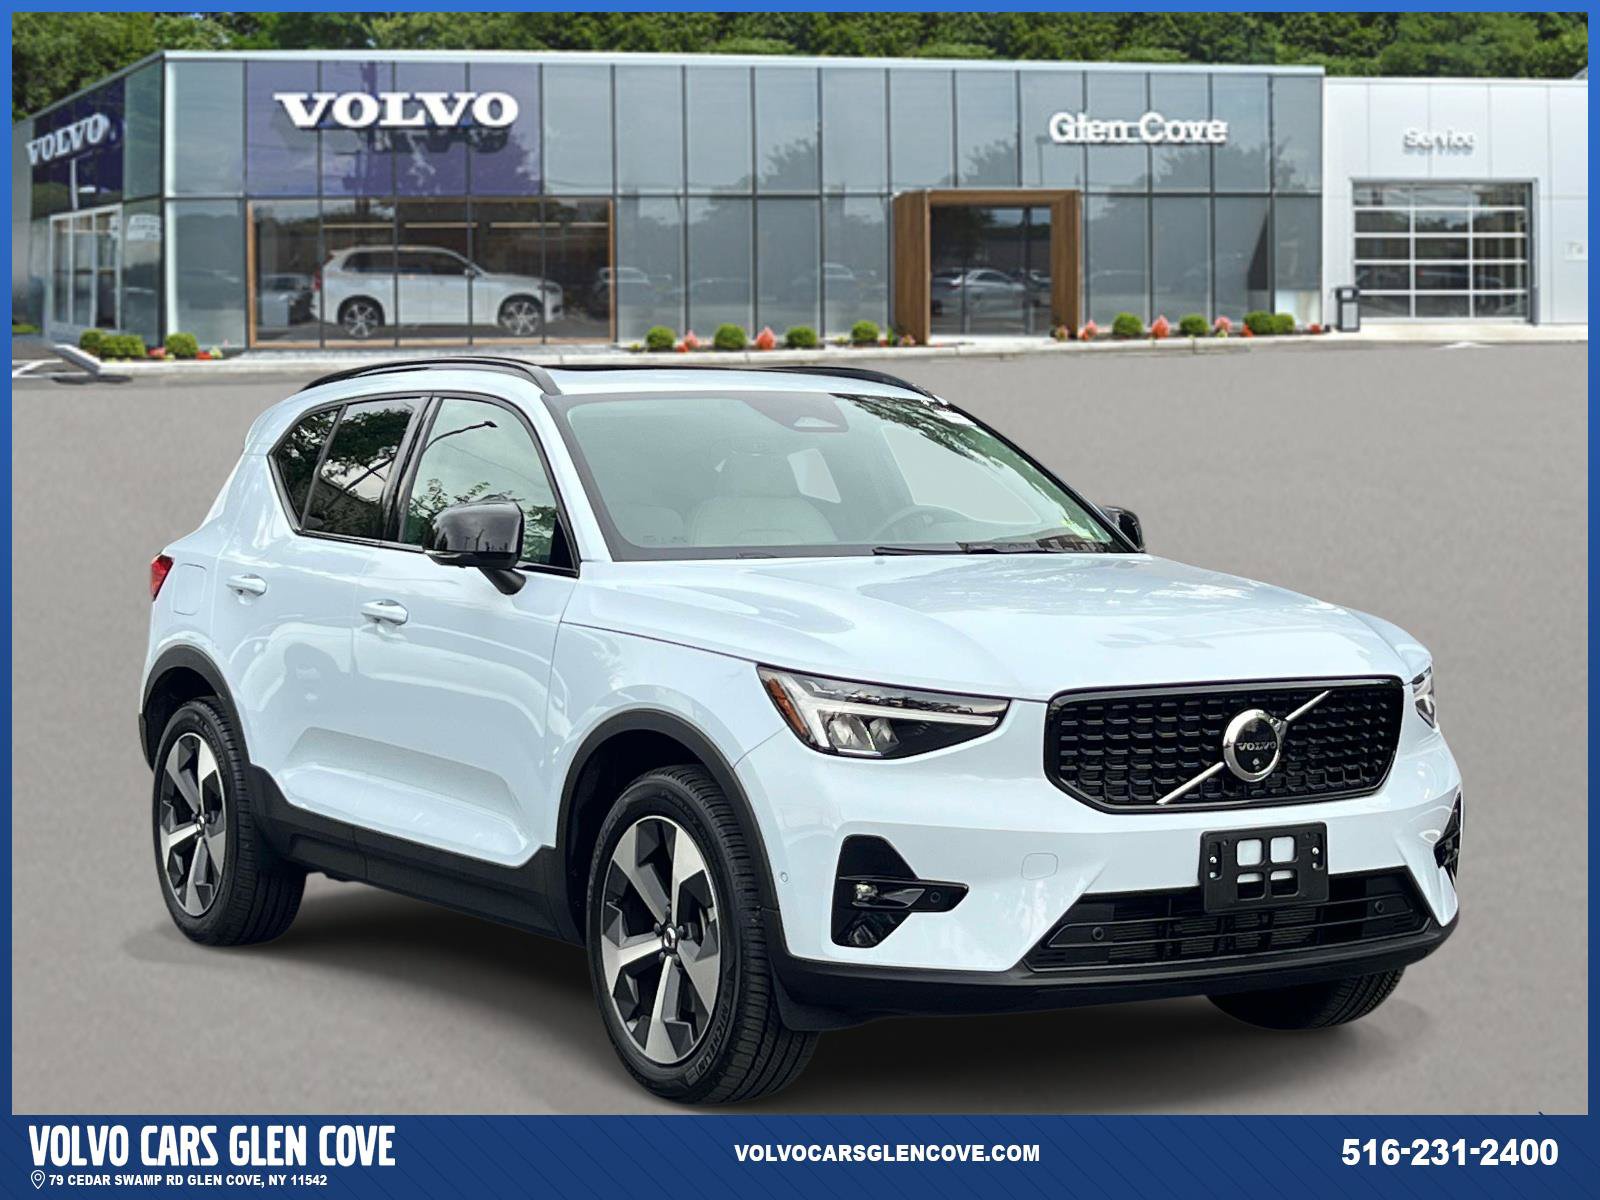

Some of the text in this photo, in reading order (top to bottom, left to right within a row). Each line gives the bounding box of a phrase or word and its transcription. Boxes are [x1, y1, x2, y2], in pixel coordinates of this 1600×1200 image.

[274, 91, 519, 128] VOLVO
[25, 112, 110, 166] VOLVO
[1049, 111, 1228, 143] Glen Cove
[1402, 128, 1476, 151] Service
[1236, 742, 1277, 751] VOLVO
